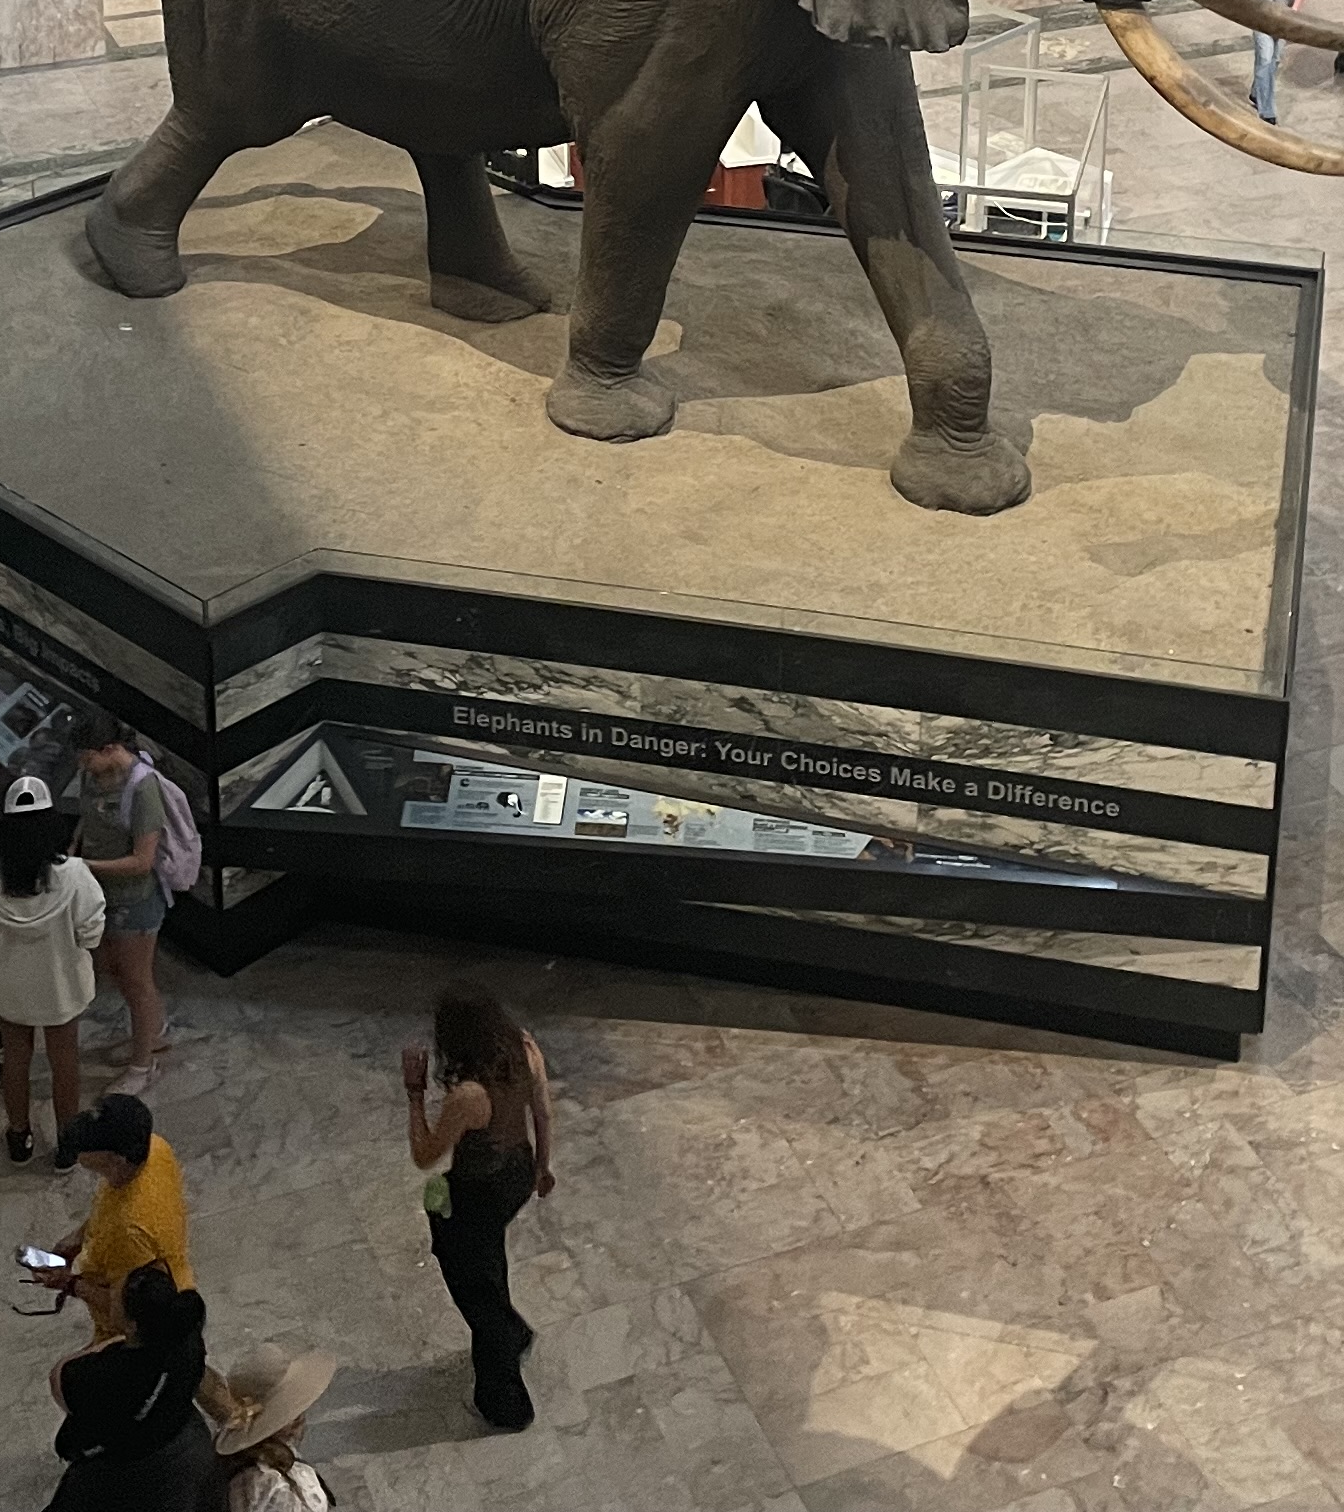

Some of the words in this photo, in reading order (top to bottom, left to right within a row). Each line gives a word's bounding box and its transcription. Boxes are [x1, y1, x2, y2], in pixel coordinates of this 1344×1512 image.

[453, 706, 573, 739] Elephants
[581, 722, 602, 744] in
[611, 727, 707, 758] Danger:
[714, 740, 773, 767] Your
[780, 750, 882, 783] Choices
[890, 766, 956, 794] Make
[964, 782, 979, 797] a
[988, 781, 1121, 818] Difference
